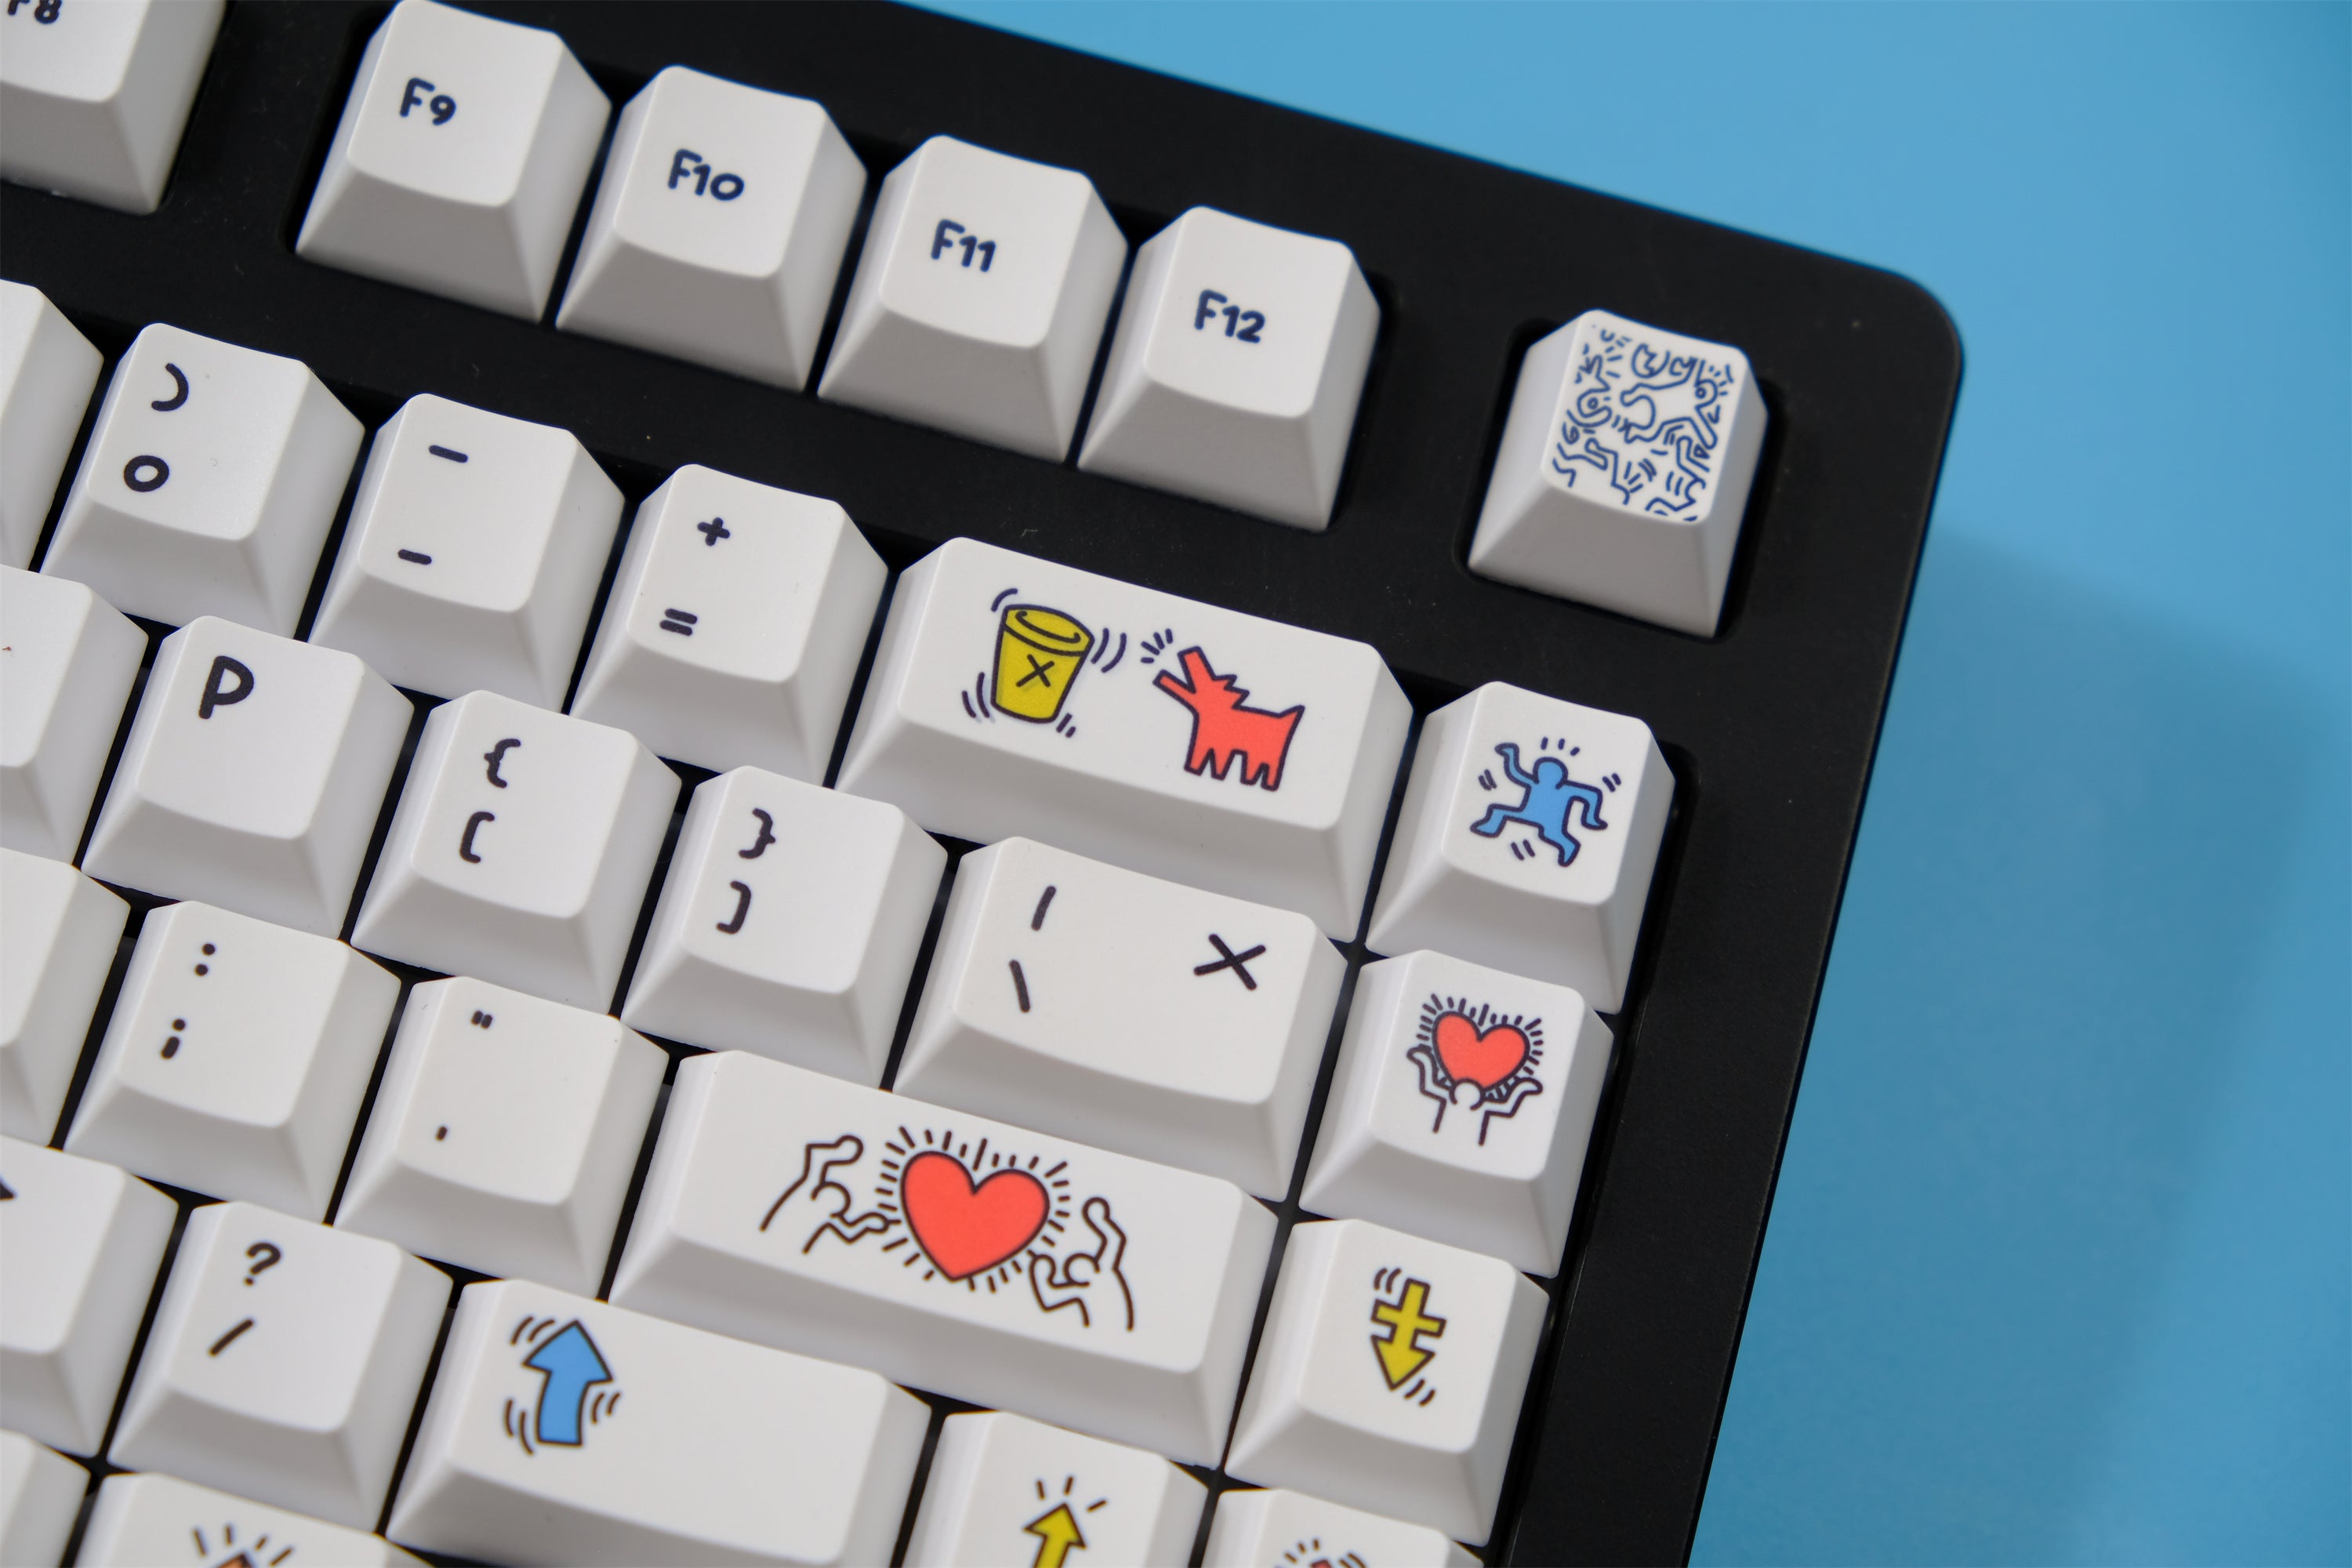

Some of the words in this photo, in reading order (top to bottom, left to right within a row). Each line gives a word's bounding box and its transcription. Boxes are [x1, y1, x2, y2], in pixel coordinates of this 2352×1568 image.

[398, 76, 457, 127] F9
[667, 148, 746, 202] F10
[930, 219, 997, 273] F11
[1193, 289, 1266, 344] F12
[696, 517, 731, 547] +
[659, 608, 699, 637] =
[198, 655, 256, 720] P
[483, 737, 522, 789] {
[738, 807, 777, 860] }
[716, 880, 753, 935] ]
[194, 942, 217, 978] :
[244, 1241, 282, 1286] ?
[209, 1318, 255, 1357] /
